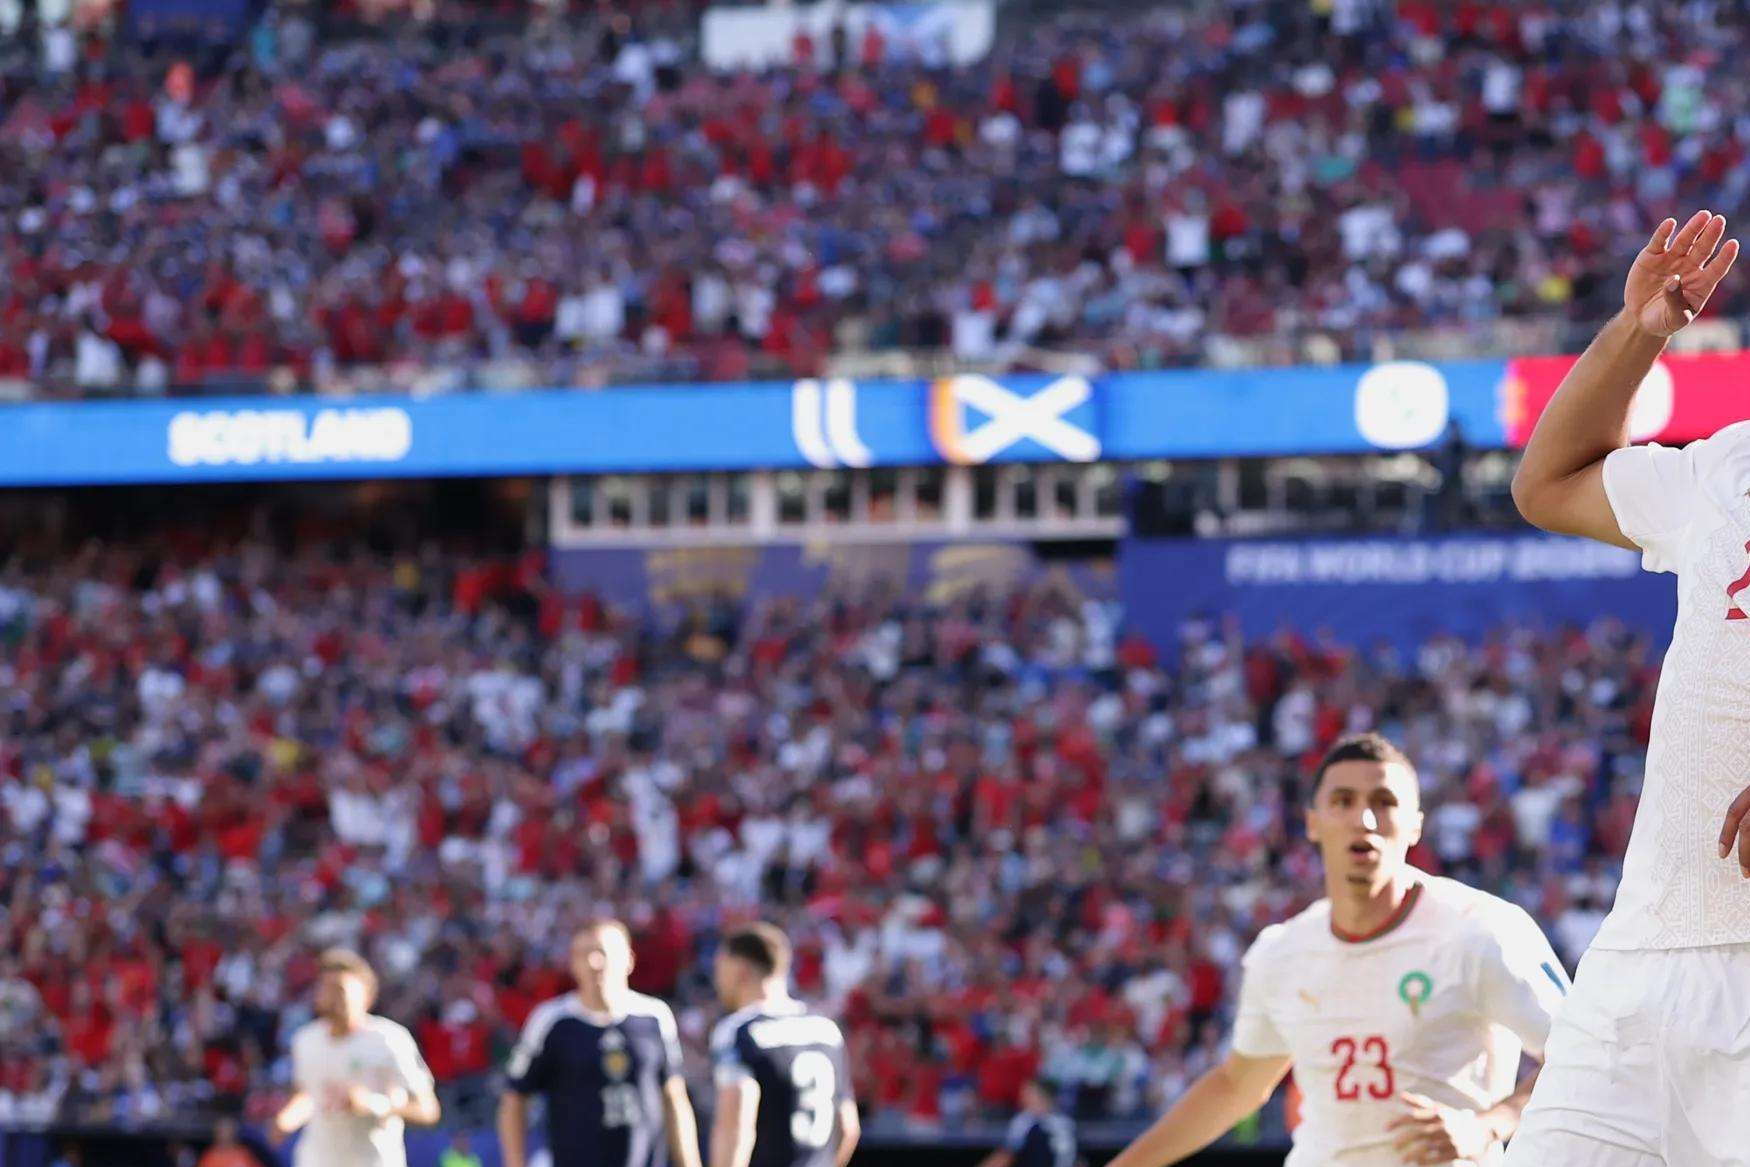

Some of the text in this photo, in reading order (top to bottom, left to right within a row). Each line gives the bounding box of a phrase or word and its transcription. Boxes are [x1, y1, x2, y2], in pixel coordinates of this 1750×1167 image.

[168, 407, 413, 466] SCOTLAND
[790, 1050, 837, 1148] 3
[1330, 1034, 1396, 1103] 23
